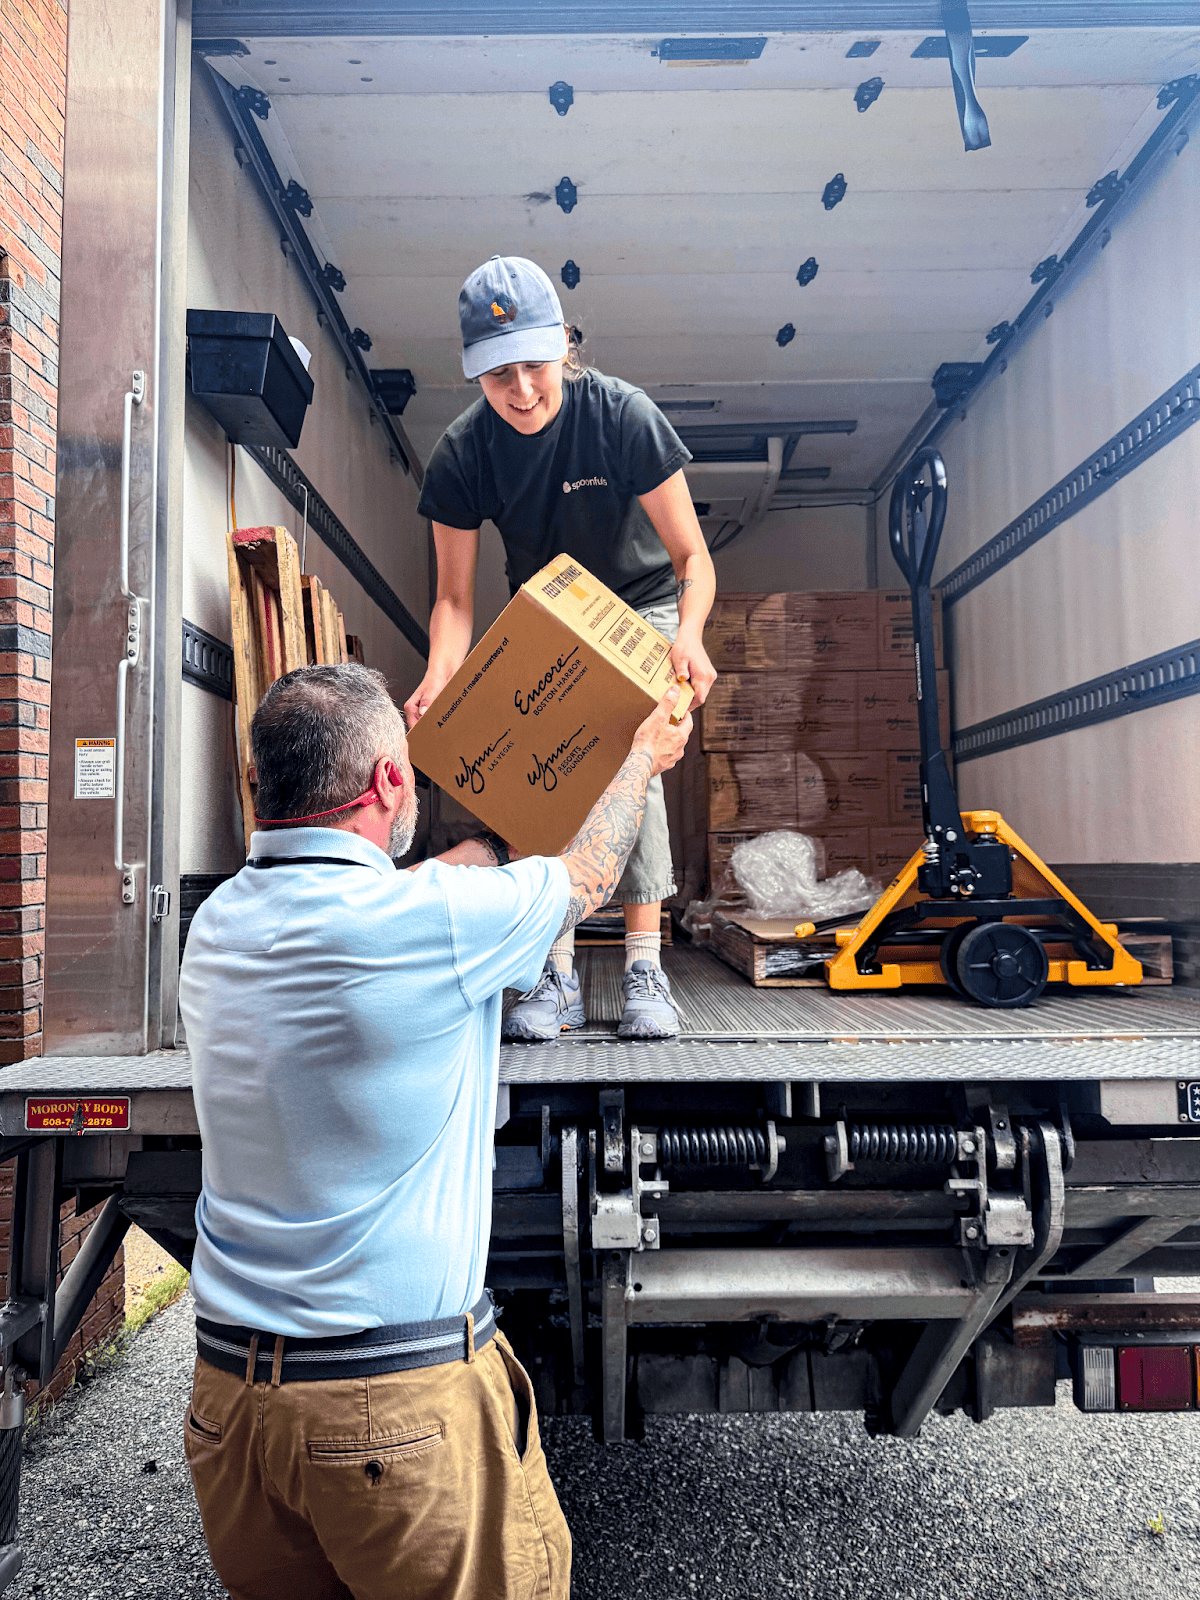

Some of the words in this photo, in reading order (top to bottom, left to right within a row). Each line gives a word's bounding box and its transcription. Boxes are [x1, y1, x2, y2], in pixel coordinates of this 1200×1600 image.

[551, 575, 569, 590] THE
[559, 564, 582, 584] FUNNEL
[541, 583, 561, 599] FEED
[442, 697, 463, 722] donation
[461, 688, 468, 697] of
[467, 672, 483, 690] meals
[481, 645, 504, 672] courtesy
[502, 636, 509, 647] of
[514, 645, 579, 715] Encore
[572, 665, 589, 684] RESORT
[532, 687, 558, 716] BOSTON
[556, 659, 582, 688] HARBOR
[487, 759, 499, 772] LAS
[497, 740, 515, 760] VEGAS
[557, 745, 582, 772] RESORTS
[563, 735, 600, 776] FOUNDATION
[93, 1103, 126, 1115] BODY
[42, 1118, 113, 1126] 508-7-2878
